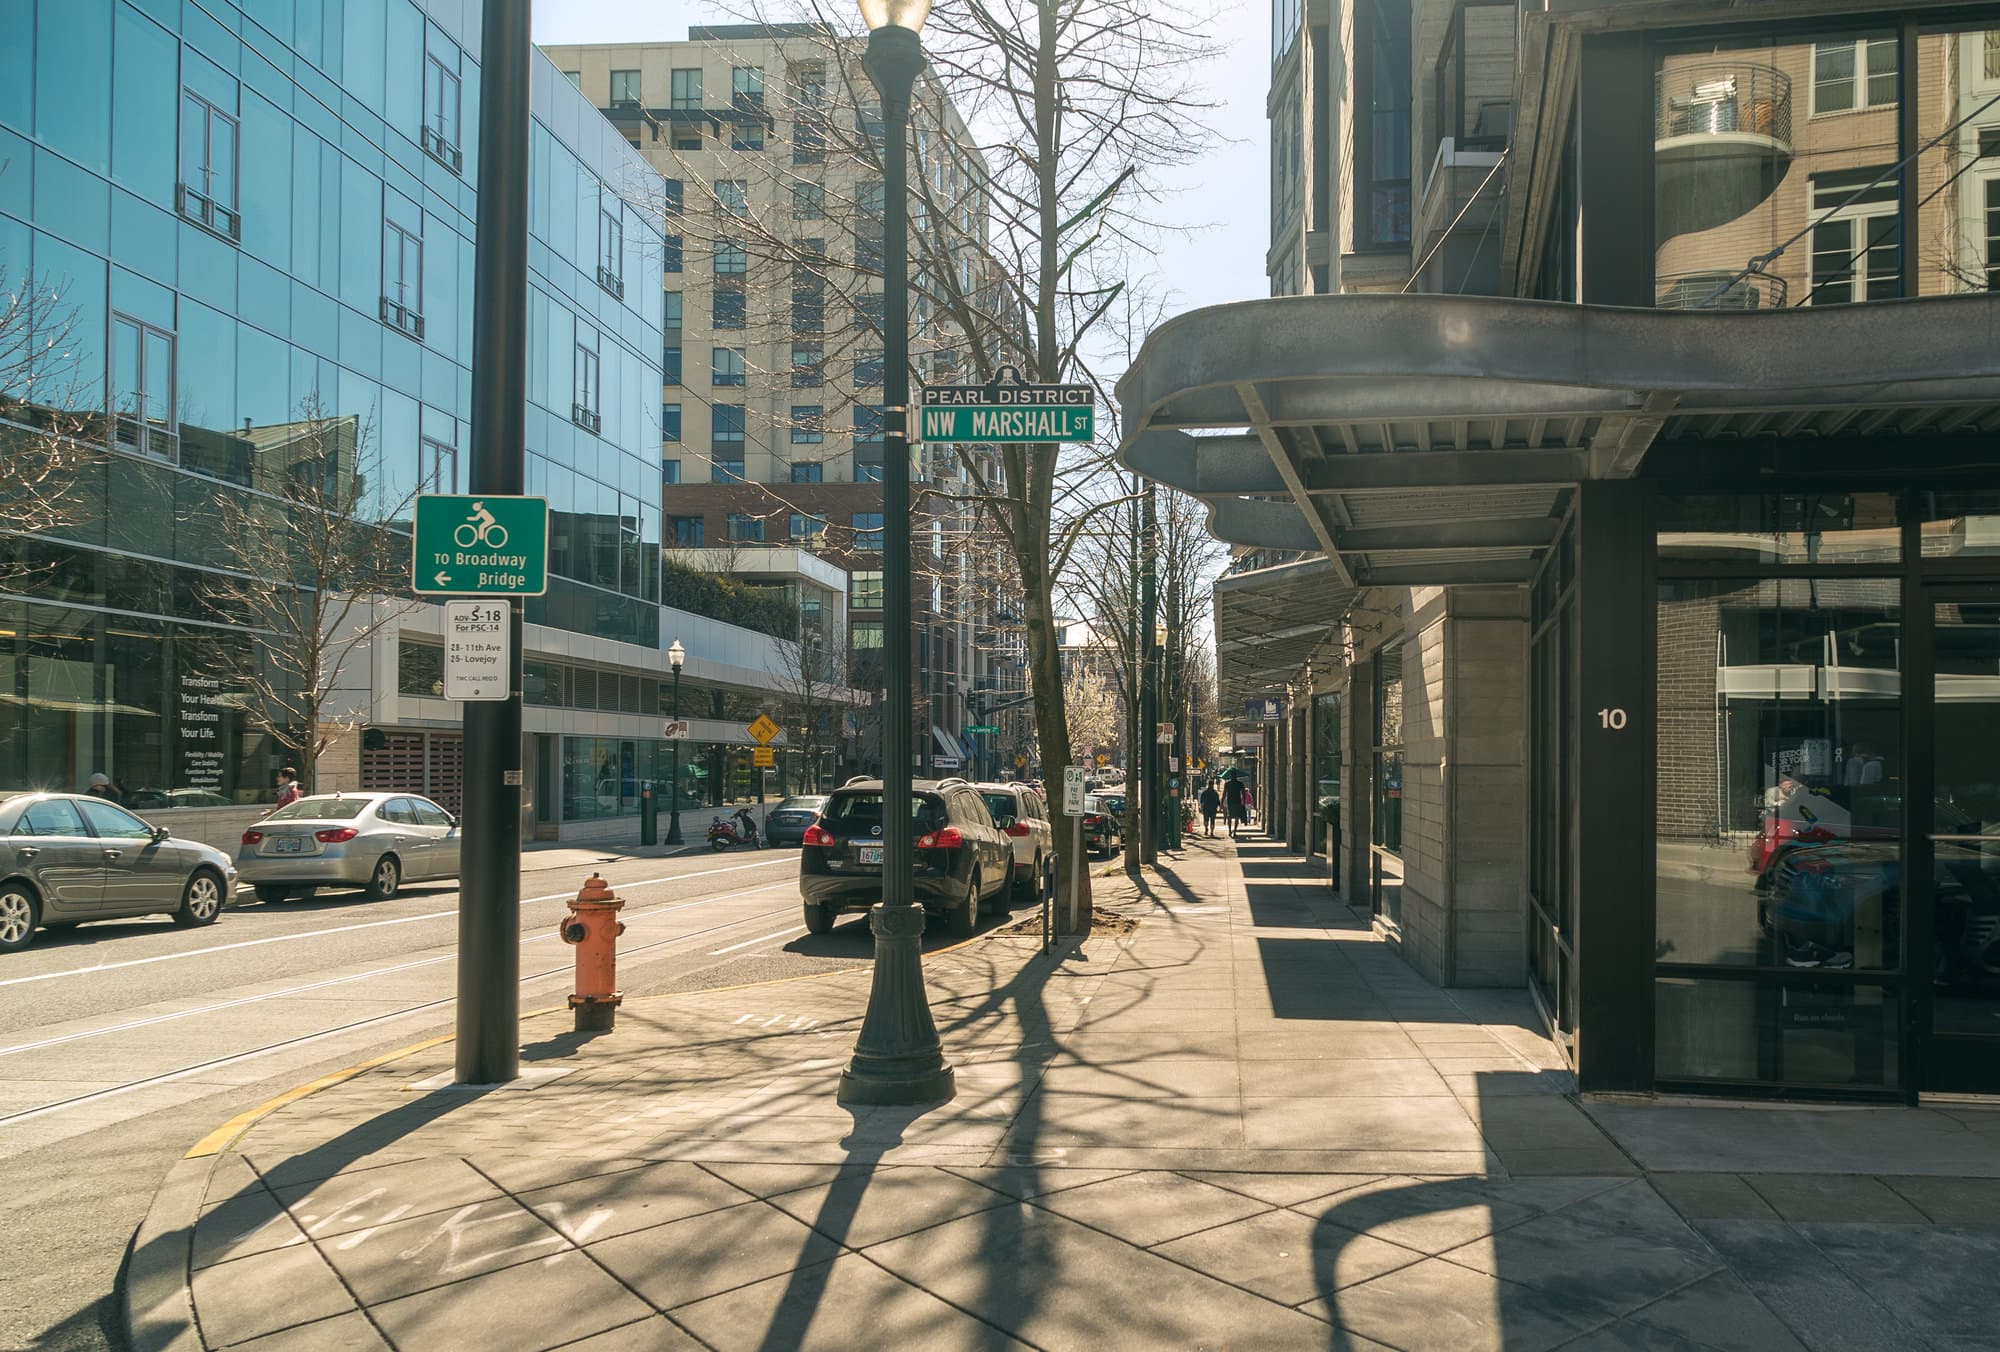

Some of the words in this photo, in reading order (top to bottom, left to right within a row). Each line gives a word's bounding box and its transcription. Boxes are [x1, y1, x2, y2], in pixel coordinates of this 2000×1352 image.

[926, 390, 991, 403] PEARL
[1000, 390, 1091, 404] DISTRICT
[927, 411, 956, 436] NW
[973, 411, 1072, 436] MARSHALL
[1074, 417, 1088, 430] ST
[455, 552, 526, 569] Broadway
[479, 572, 526, 589] Bridge
[466, 643, 484, 651] 11th
[485, 643, 502, 651] Ave
[465, 655, 497, 664] Lovejoy
[181, 676, 219, 688] Transform
[181, 693, 199, 704] Your
[181, 710, 219, 721] Transform
[1598, 709, 1627, 729] 10
[181, 728, 199, 738] Your
